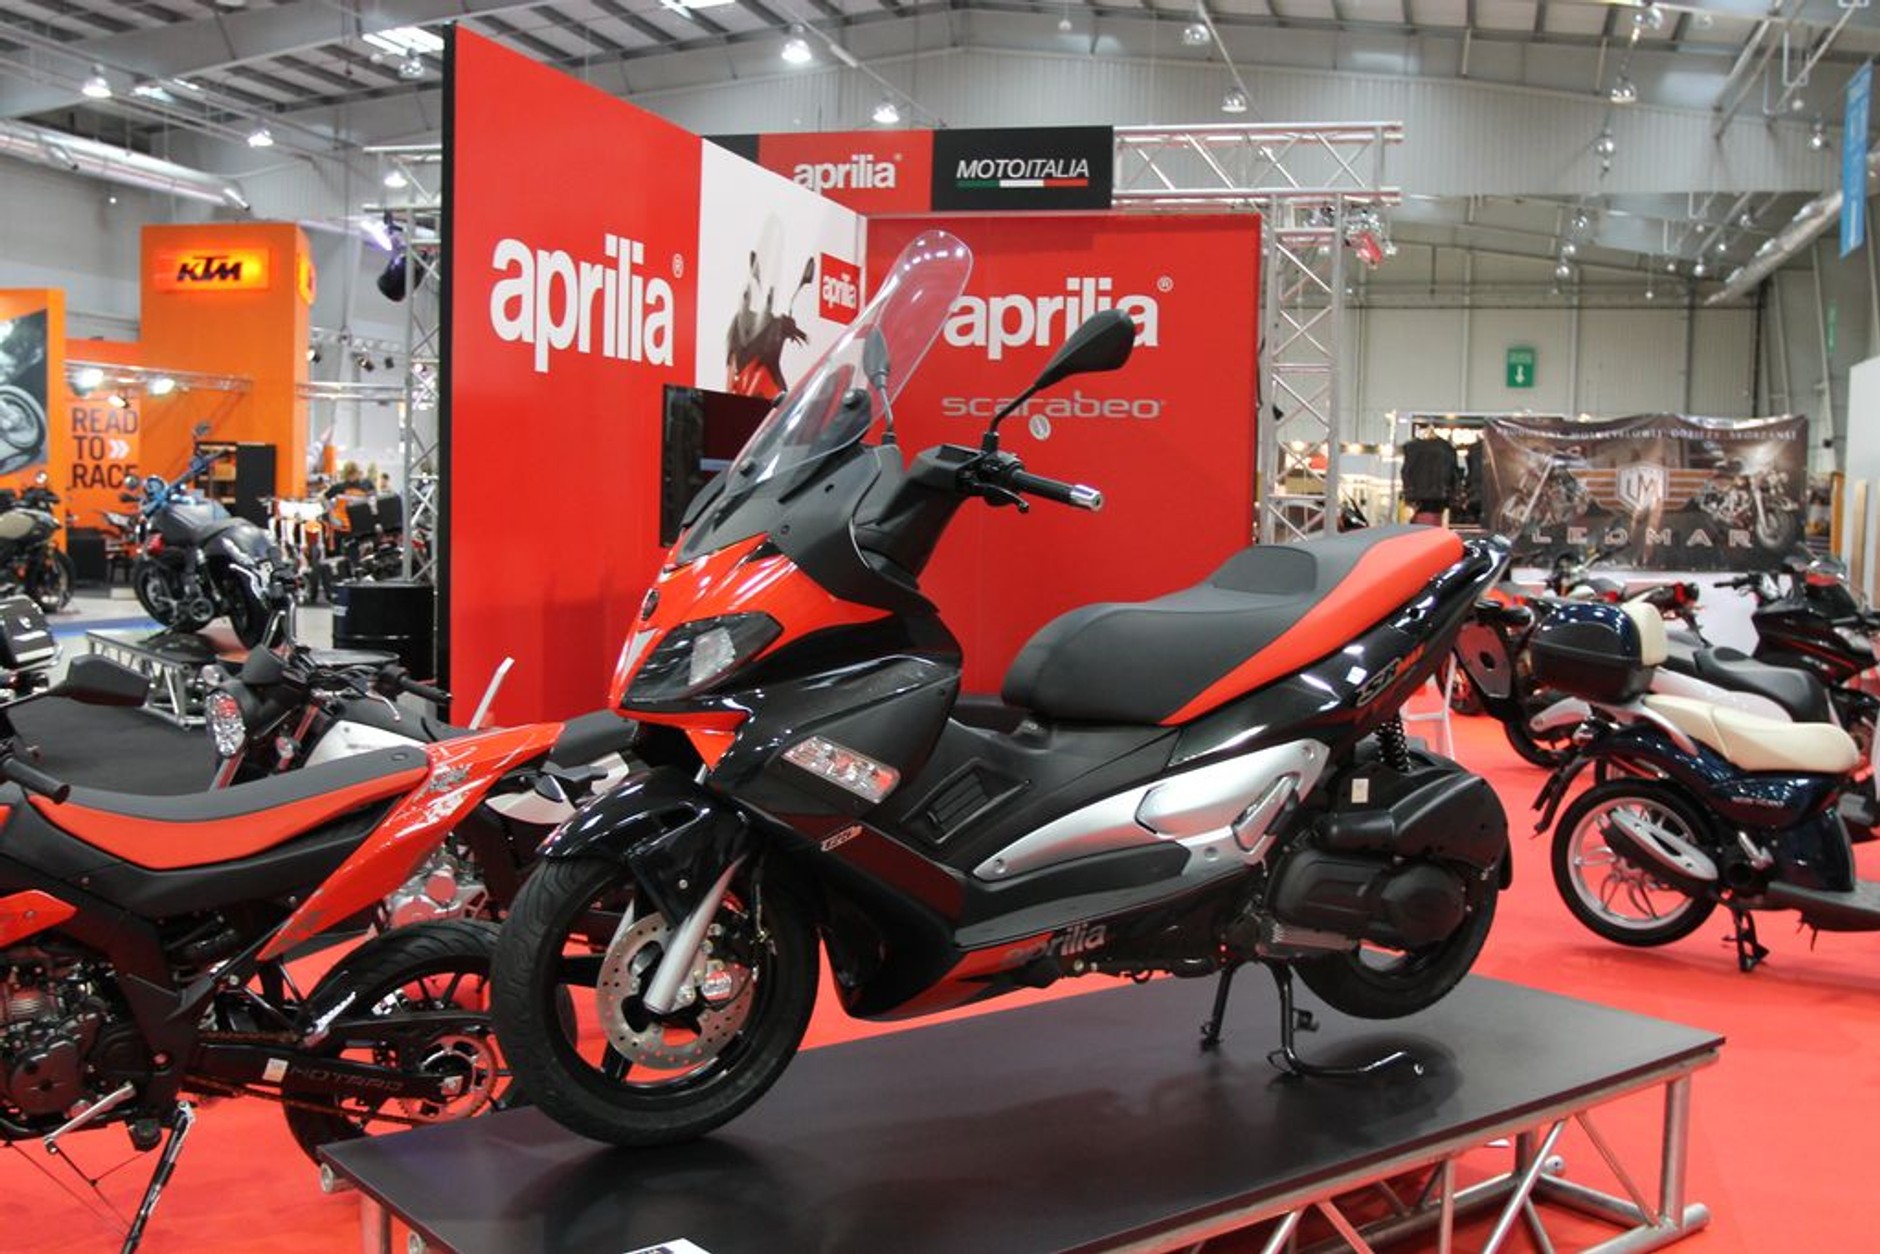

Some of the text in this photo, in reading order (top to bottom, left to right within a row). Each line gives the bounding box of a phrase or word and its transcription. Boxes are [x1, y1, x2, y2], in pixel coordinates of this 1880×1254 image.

[792, 154, 896, 195] aprilia
[956, 158, 1090, 180] MOTOITALIA
[176, 256, 243, 281] KTM
[490, 233, 675, 373] aprilia
[942, 389, 1161, 419] scarabeo
[72, 436, 105, 461] TO
